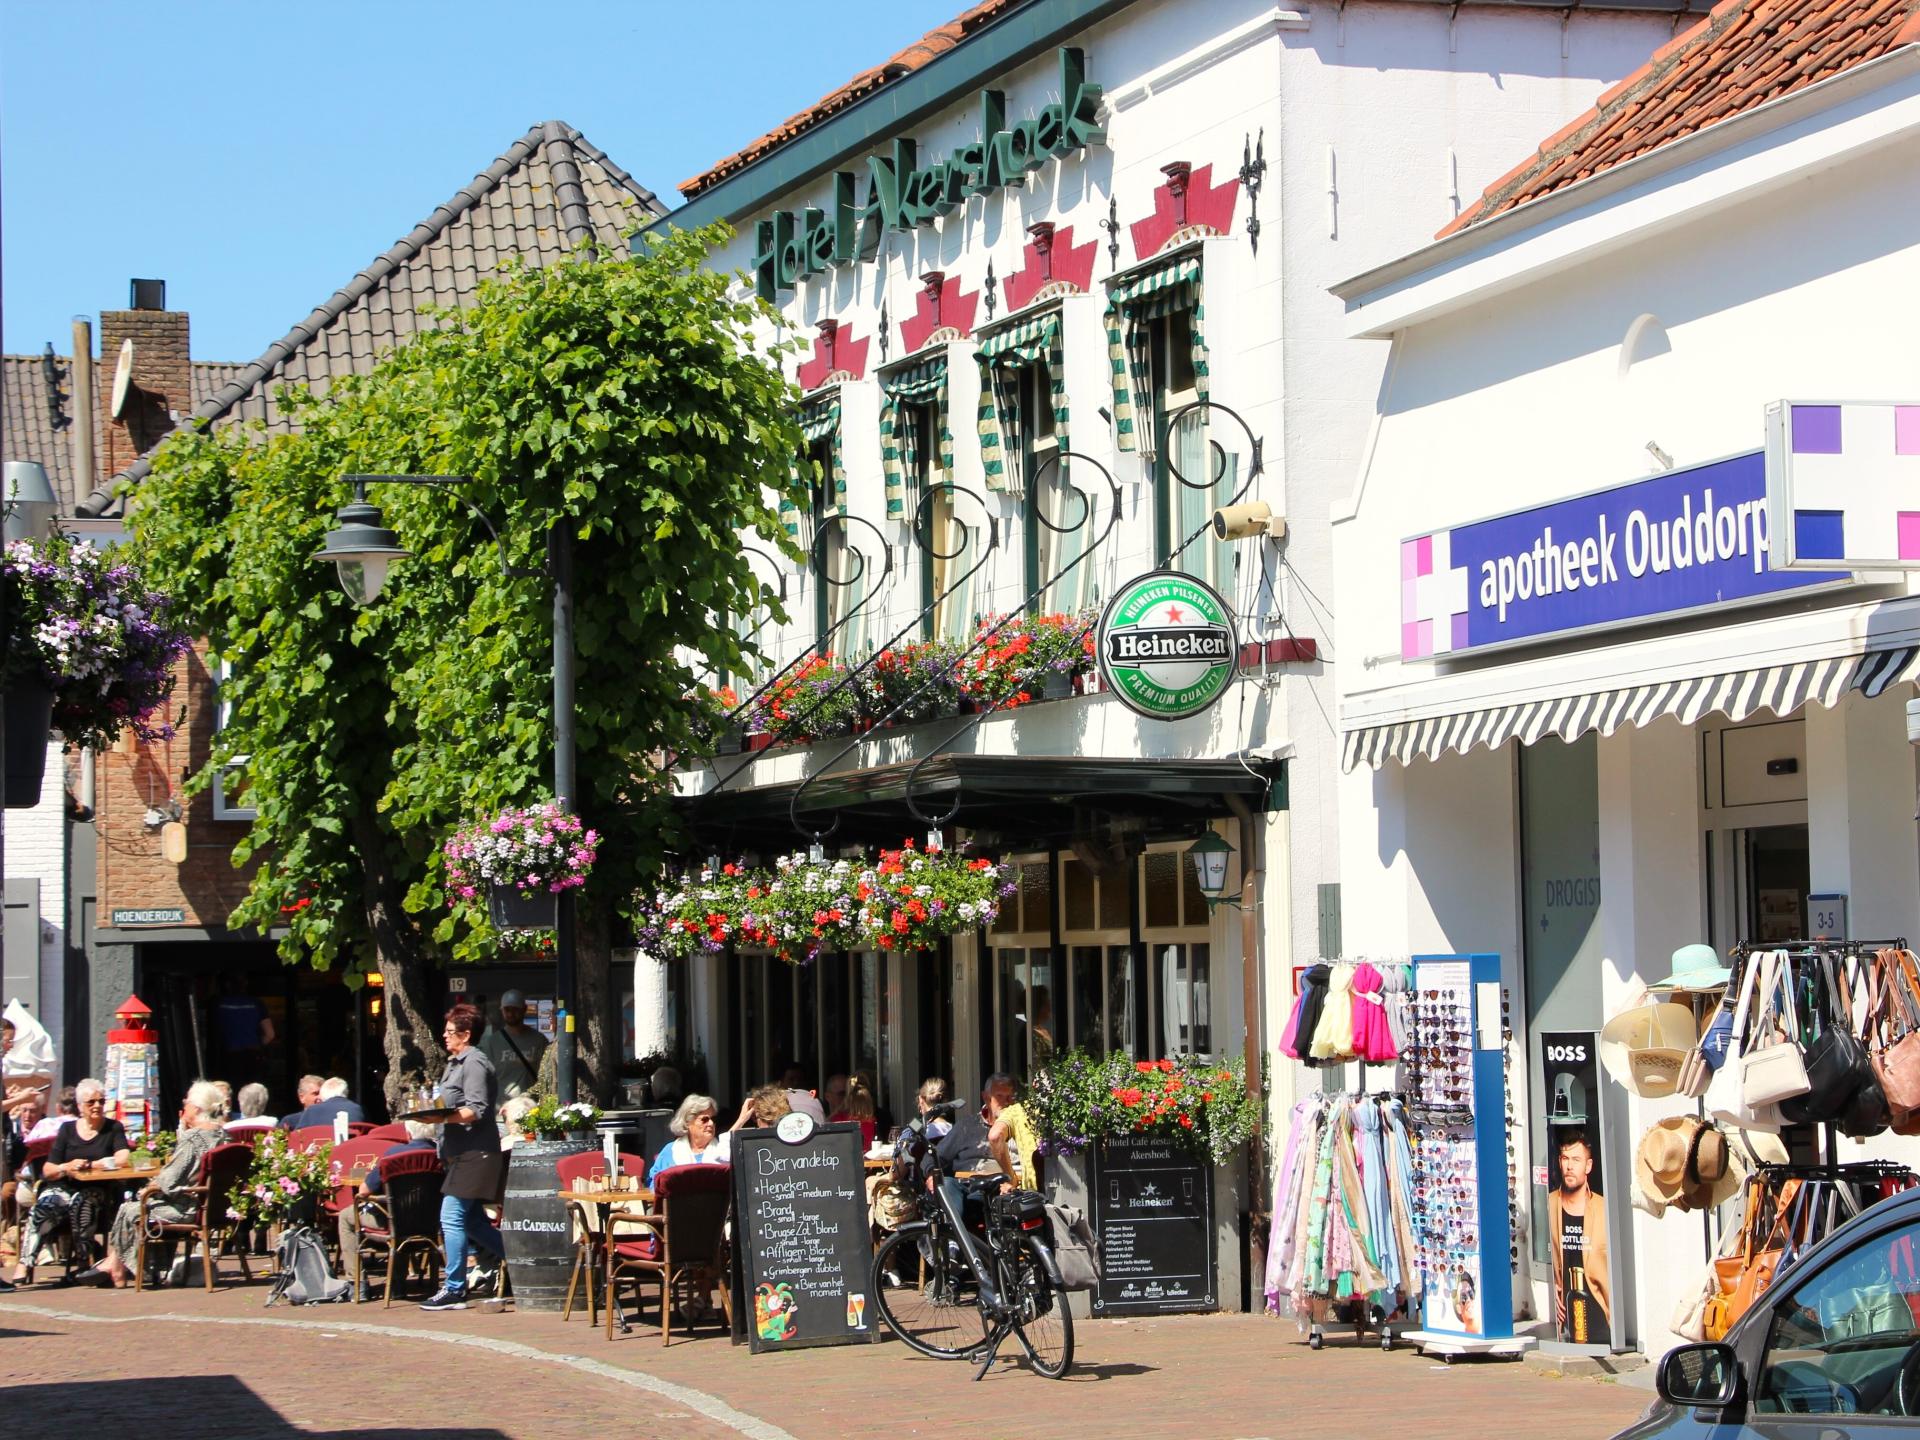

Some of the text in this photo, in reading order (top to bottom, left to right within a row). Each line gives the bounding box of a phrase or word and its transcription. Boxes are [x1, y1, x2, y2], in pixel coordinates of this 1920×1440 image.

[751, 47, 1108, 303] Hotel Akershoek
[1480, 488, 1770, 623] apotheek Ouddorp
[1124, 586, 1214, 619] HEINEKEN PILSENER
[1118, 633, 1226, 658] Heineken
[1127, 673, 1176, 705] PREMIUM
[1180, 671, 1219, 704] QUALITY
[452, 979, 464, 991] 19
[1547, 1045, 1587, 1062] BOSS
[1108, 1137, 1129, 1147] Hotel
[1131, 1137, 1149, 1147] Café
[757, 1148, 788, 1176] Bier
[1130, 1149, 1171, 1160] Akershoek
[759, 1176, 809, 1196] Heineken
[762, 1201, 792, 1218] Brand
[1129, 1197, 1174, 1208] Heineken
[513, 1220, 522, 1231] DE
[815, 1221, 838, 1235] blond
[1565, 1225, 1583, 1234] BOSS
[809, 1244, 834, 1255] blond
[768, 1261, 841, 1280] Grimbergen dubbel
[800, 1278, 817, 1291] Bier
[810, 1287, 843, 1298] moment
